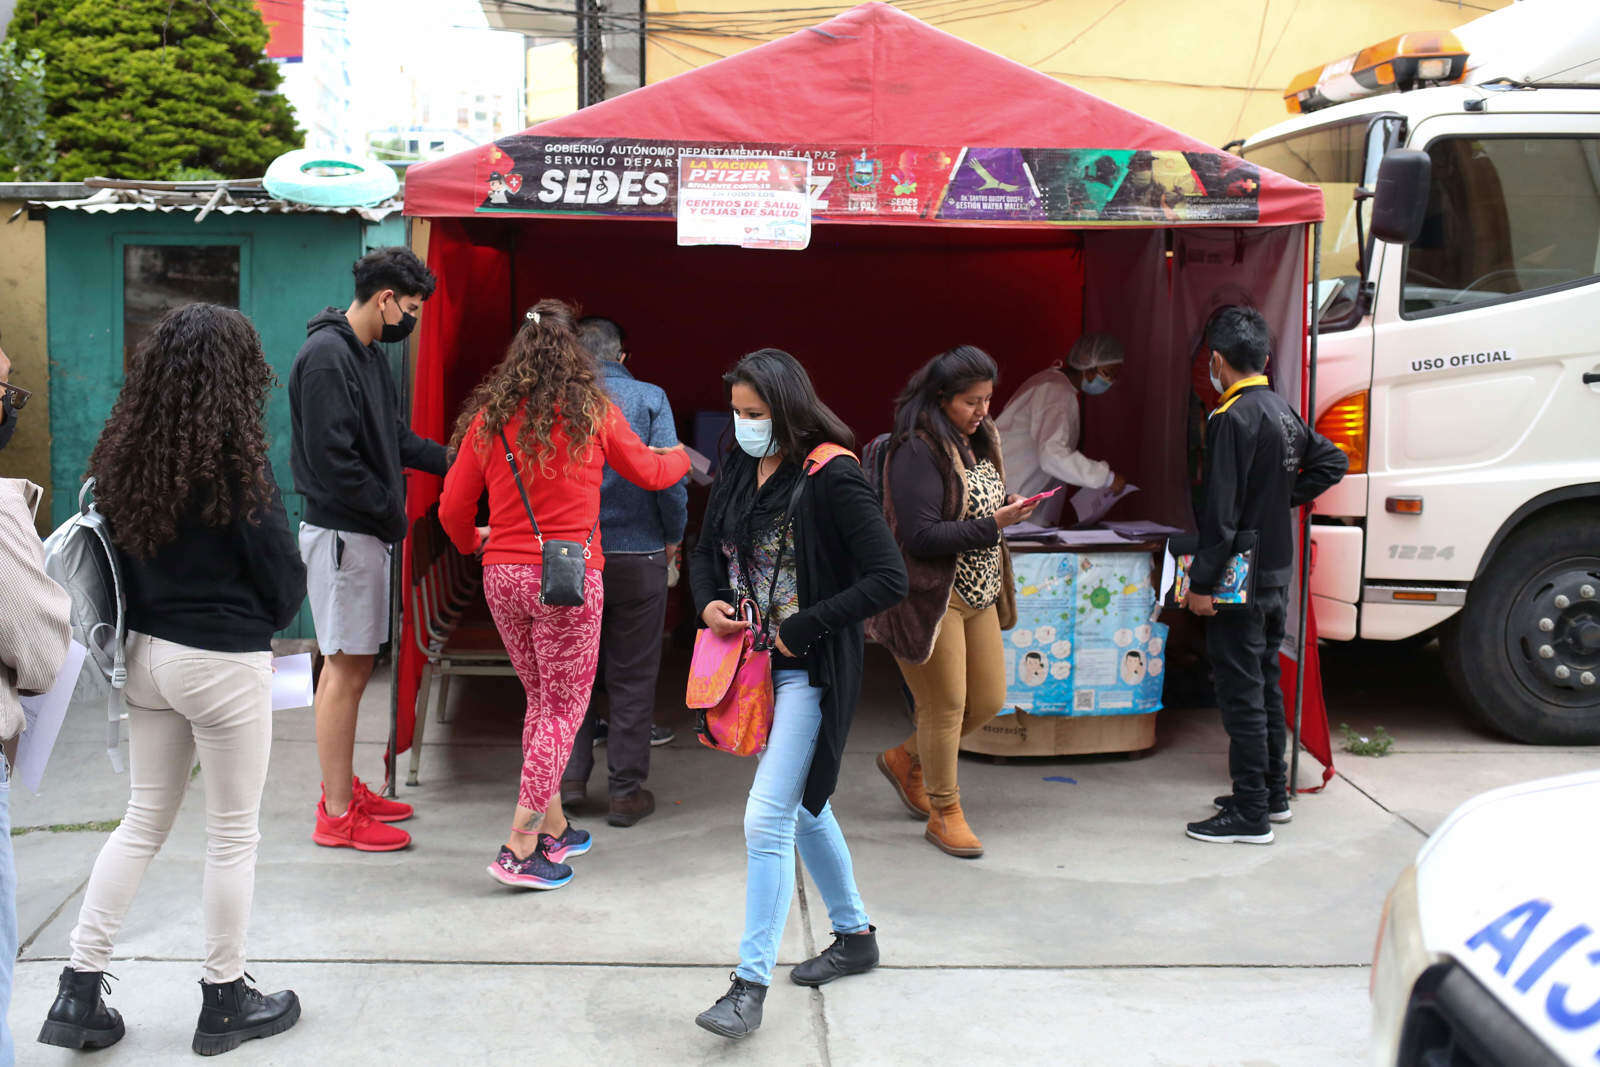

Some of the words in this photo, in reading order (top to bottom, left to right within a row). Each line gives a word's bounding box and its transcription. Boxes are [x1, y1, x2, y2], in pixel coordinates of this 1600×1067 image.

[544, 143, 605, 154] GOBIERNO
[610, 143, 675, 156] AUTÓNOMO
[679, 147, 774, 157] DEPARTAMENTAL
[779, 150, 794, 158] DE
[797, 150, 811, 159] LA
[814, 151, 837, 160] PAZ
[544, 155, 616, 166] SERVICIO
[689, 160, 707, 169] LA
[712, 160, 769, 170] VACUNA
[688, 169, 771, 182] PFIZER
[537, 168, 669, 206] SEDES
[811, 176, 834, 209] Z
[685, 199, 741, 208] CENTROS
[744, 200, 760, 209] DE
[700, 208, 737, 216] CAJAS
[740, 208, 756, 216] DE
[759, 208, 799, 218] SALUD
[1412, 357, 1445, 372] USO
[1450, 350, 1512, 367] OFICIAL
[1388, 544, 1455, 561] 1224
